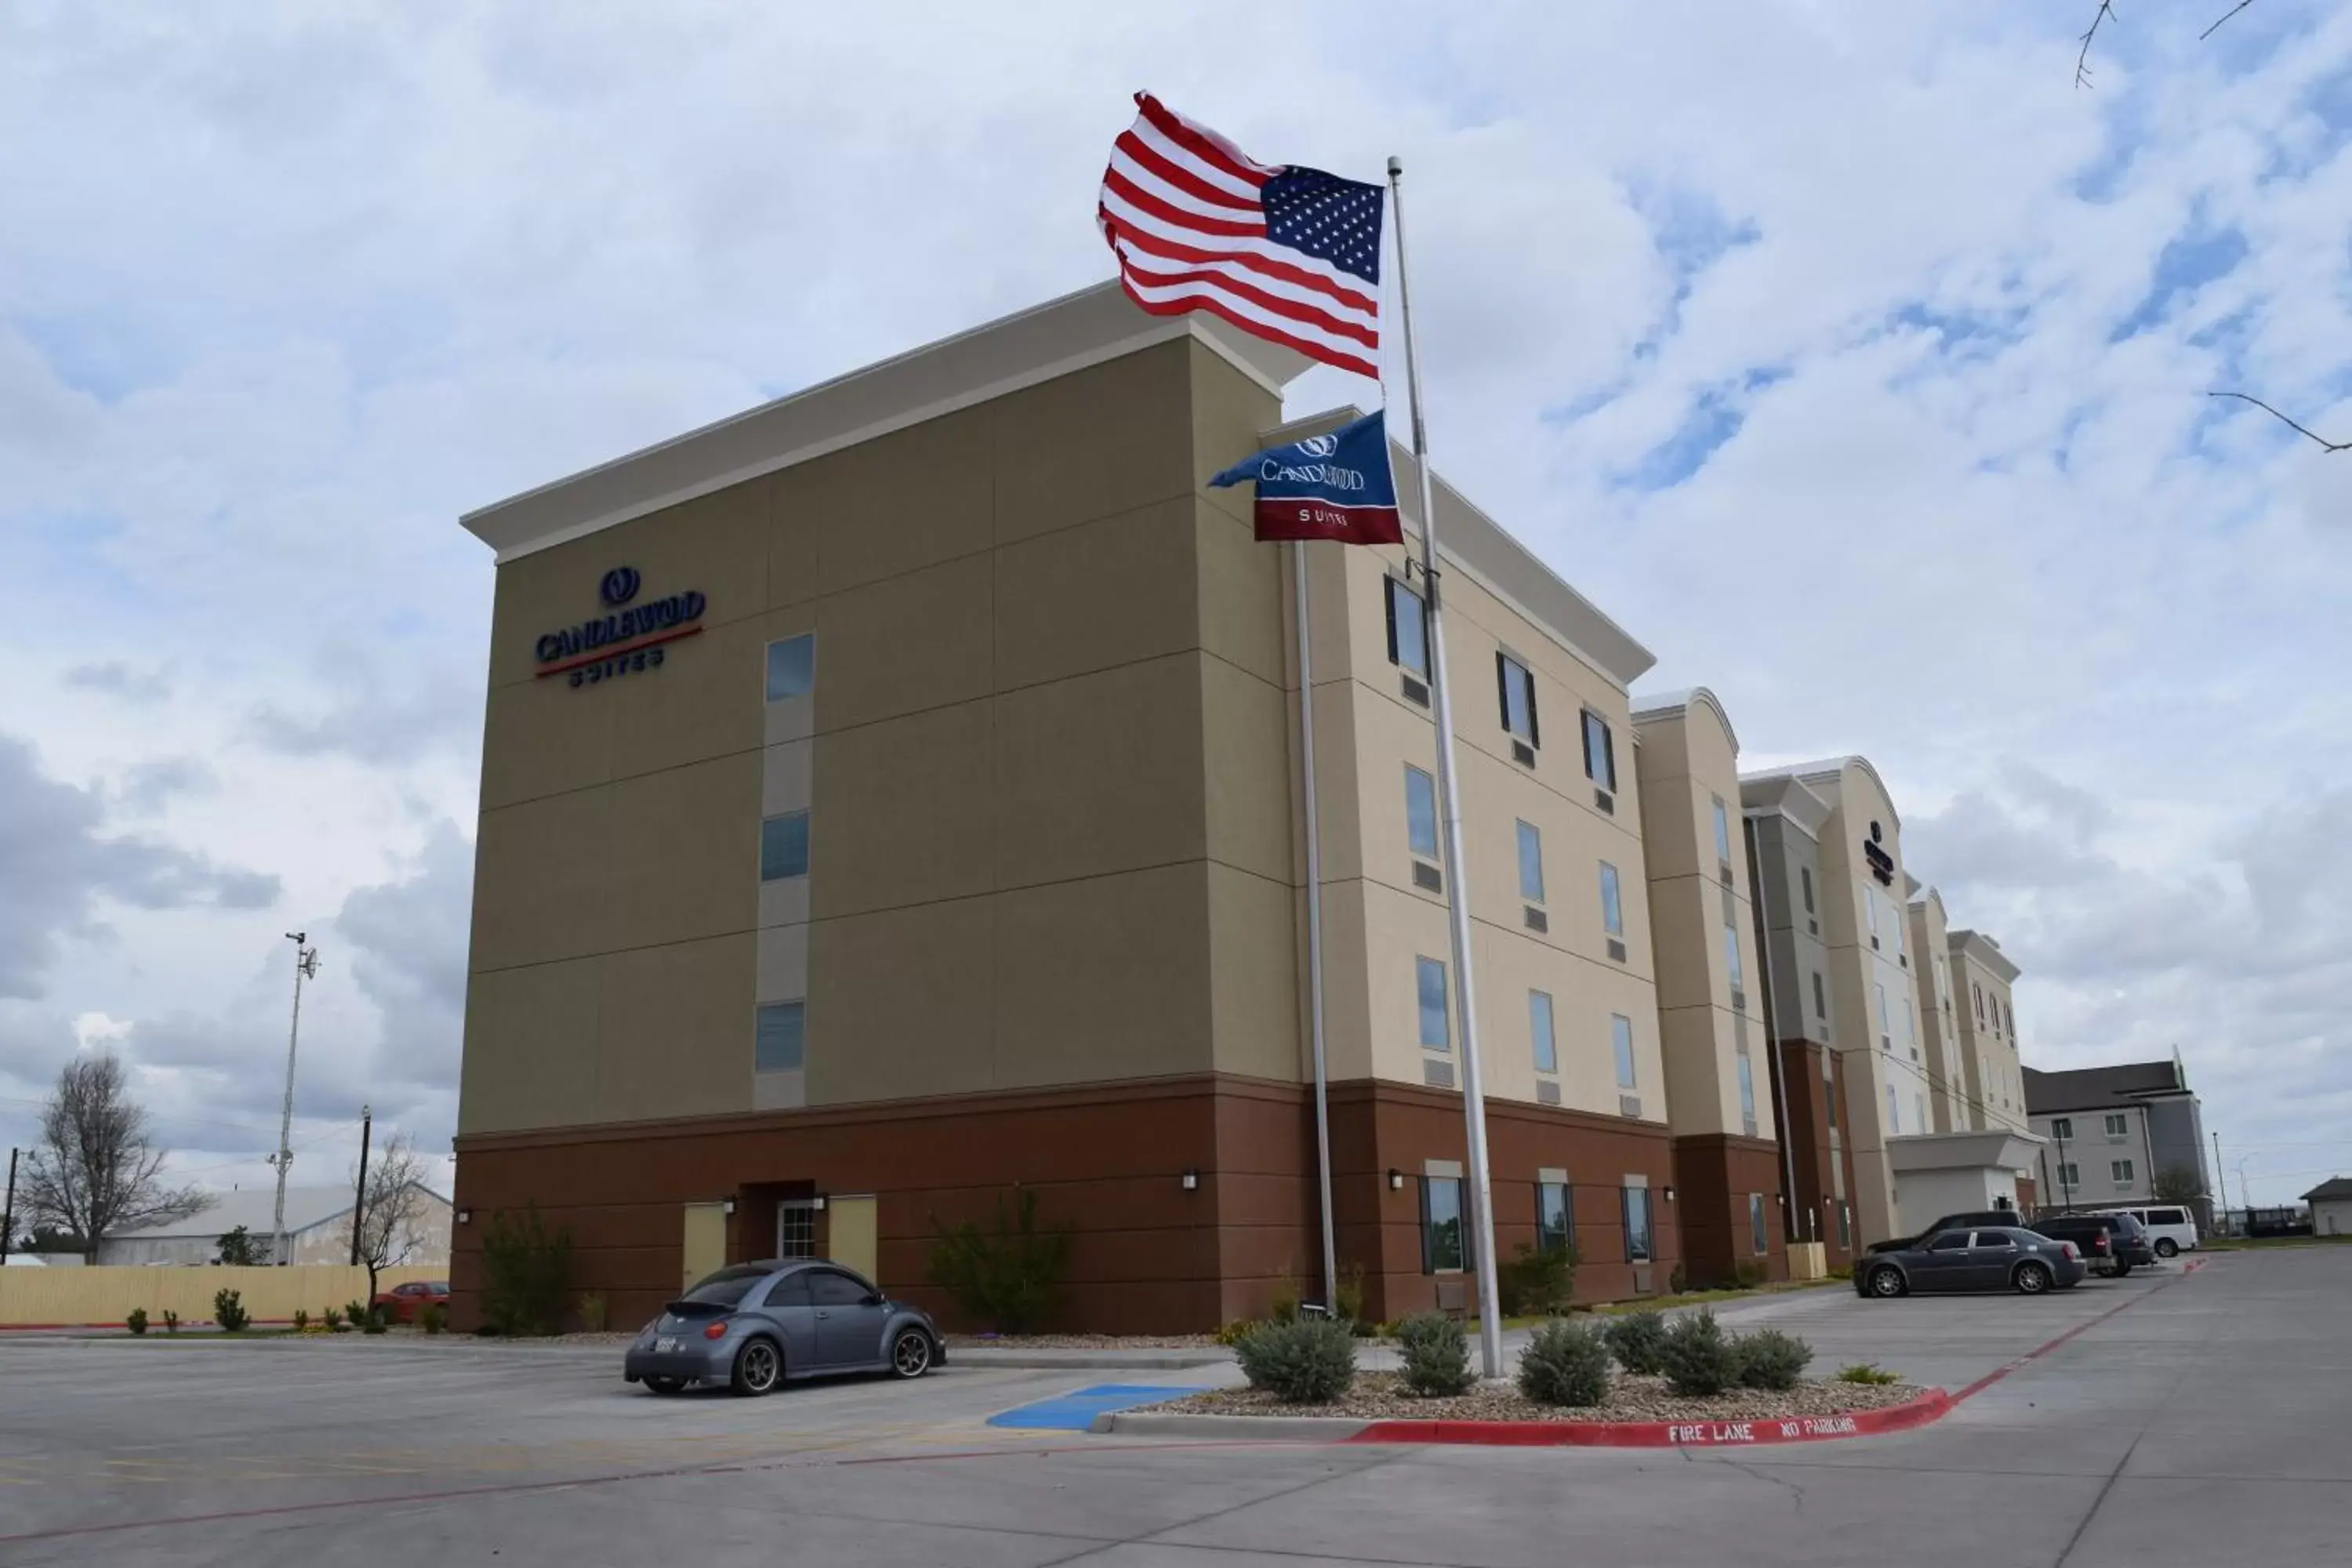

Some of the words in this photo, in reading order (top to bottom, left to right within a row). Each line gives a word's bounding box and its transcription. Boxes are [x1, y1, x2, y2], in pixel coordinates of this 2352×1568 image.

[568, 648, 664, 688] SUITES
[1668, 1425, 1706, 1442] FIRE
[1713, 1423, 1754, 1441] LANE
[1780, 1421, 1800, 1437] NO
[1805, 1417, 1857, 1435] PARKING
